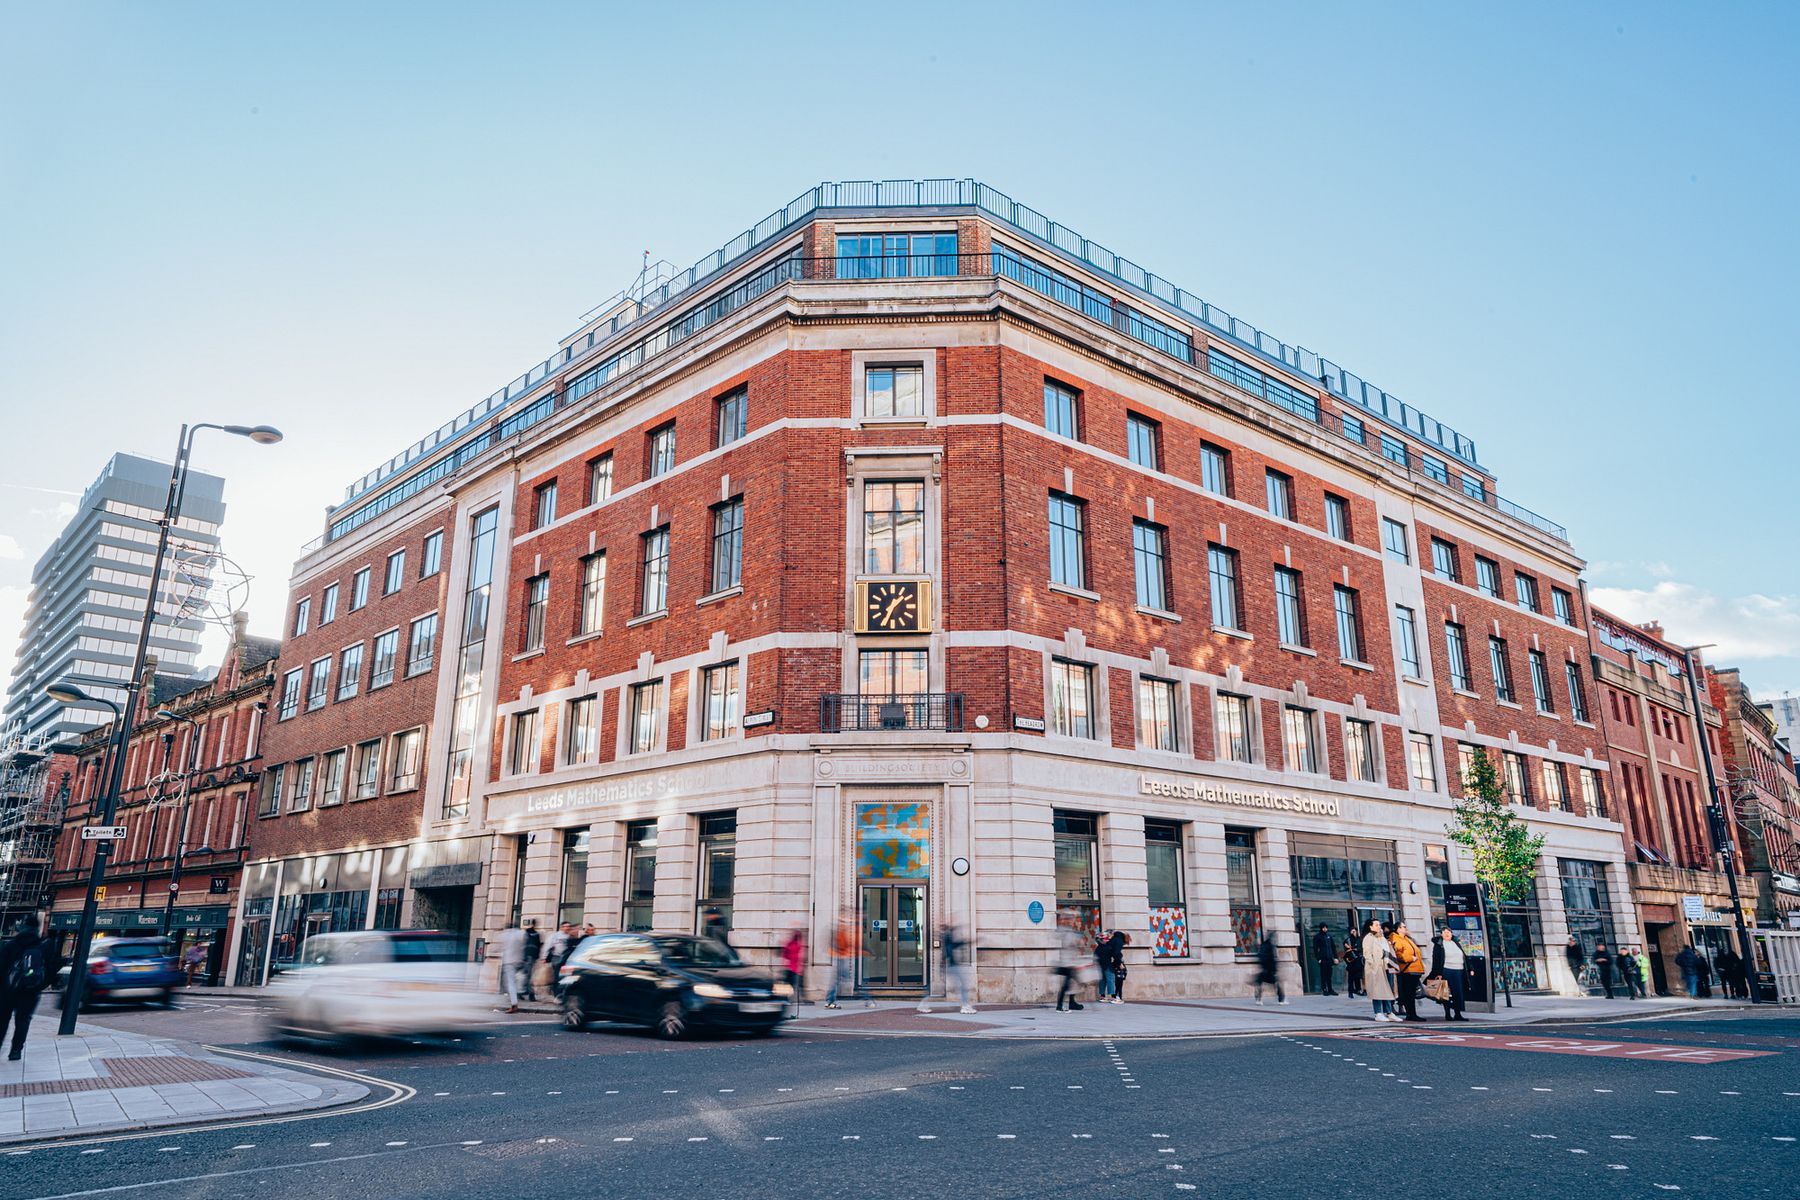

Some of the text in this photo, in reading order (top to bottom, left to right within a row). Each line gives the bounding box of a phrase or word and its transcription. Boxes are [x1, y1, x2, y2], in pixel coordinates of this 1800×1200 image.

[527, 774, 711, 812] Leeds Mathematics School
[1139, 774, 1341, 816] Leeds Mathematics School
[215, 879, 226, 887] W
[1505, 1040, 1754, 1060] GATE
